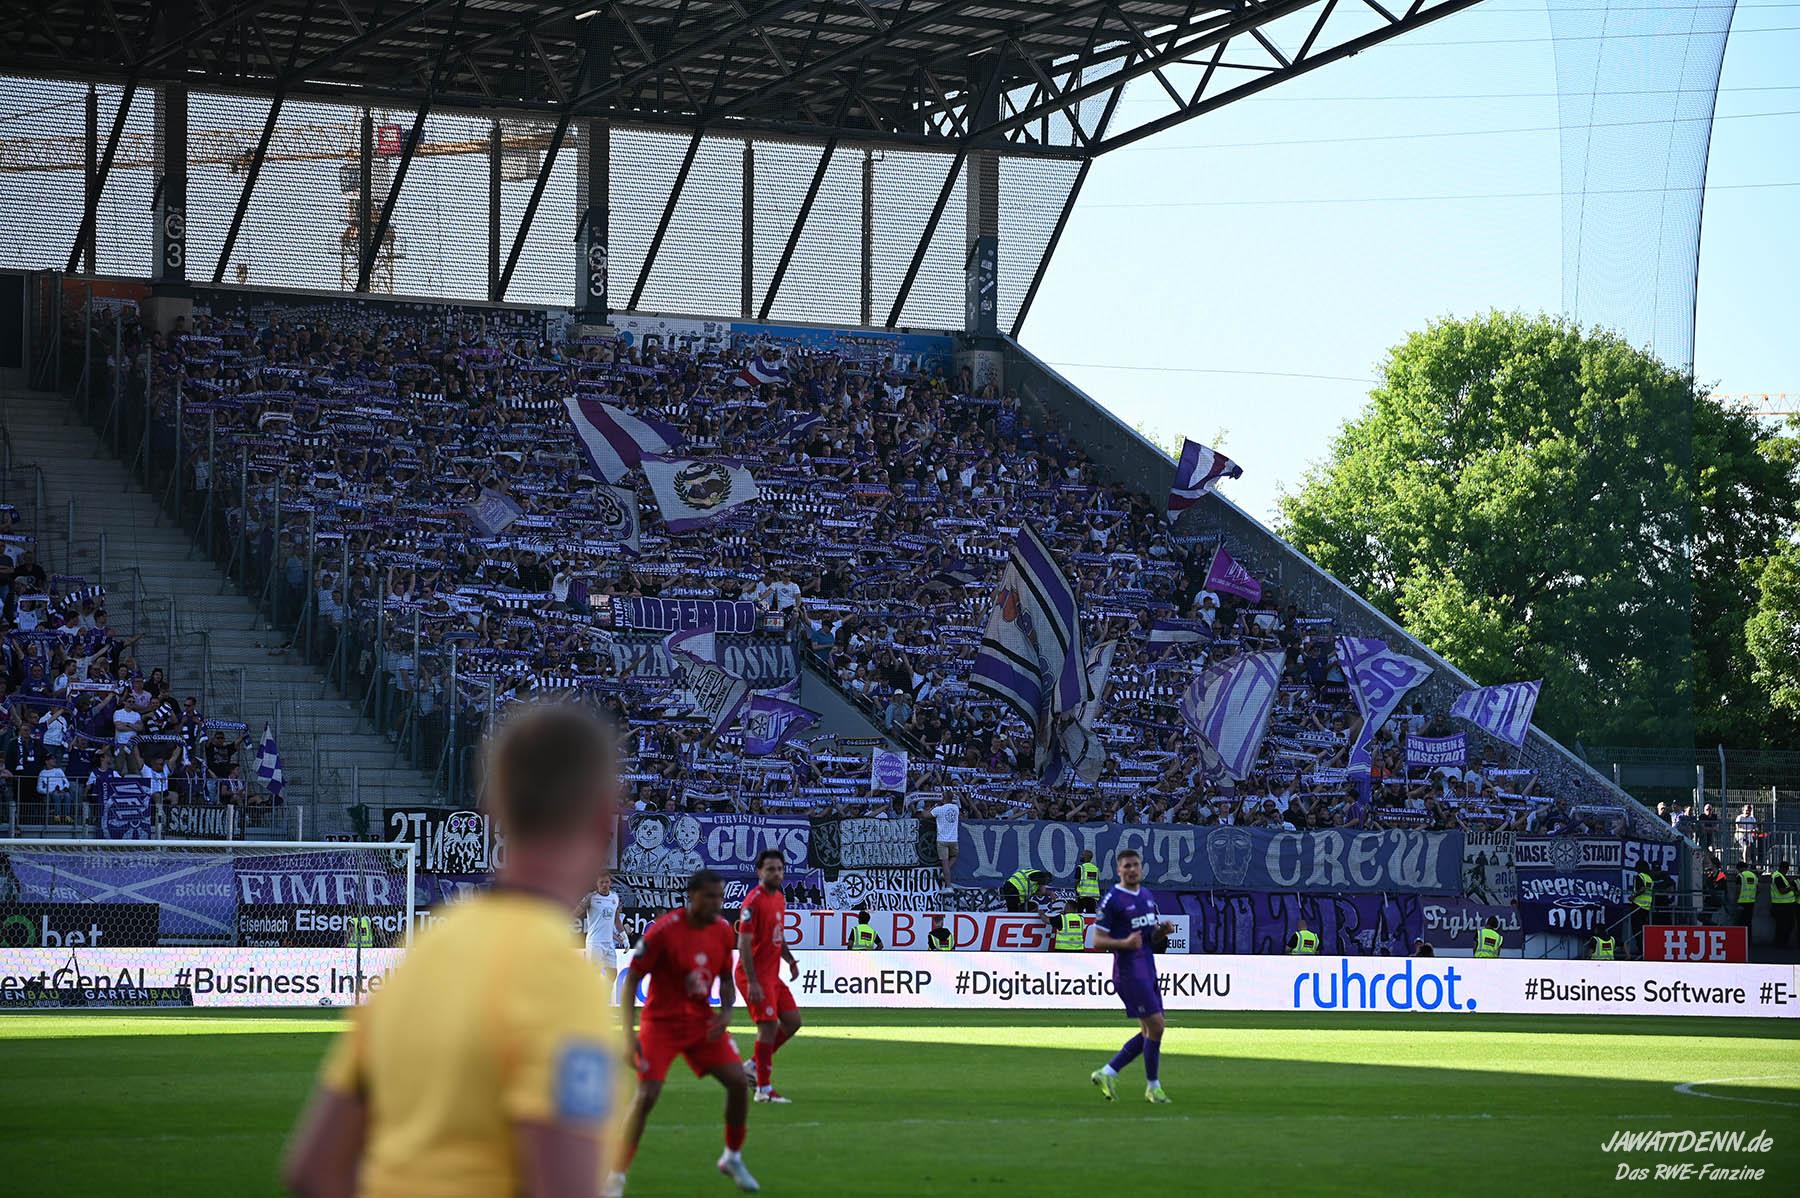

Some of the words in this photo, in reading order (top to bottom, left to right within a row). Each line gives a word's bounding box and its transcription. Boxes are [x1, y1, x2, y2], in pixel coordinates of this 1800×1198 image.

[1407, 750, 1465, 763] HASESTADT
[707, 825, 810, 865] GUYS
[960, 821, 1196, 885] VIOLET
[1265, 829, 1448, 888] CREW
[1515, 844, 1549, 862] HASE
[1581, 844, 1620, 863] STADT
[295, 910, 408, 933] Eisenach
[1663, 930, 1727, 961] HJE
[84, 989, 182, 1000] GARTENBAU
[175, 966, 320, 994] #Business
[802, 970, 932, 996] #LeanERP
[955, 969, 1118, 1000] #Digitalizatio
[1157, 973, 1231, 997] #KMU
[1293, 958, 1478, 1010] ruhrdot.
[1524, 977, 1637, 1002] #Business
[1643, 980, 1746, 1005] Software
